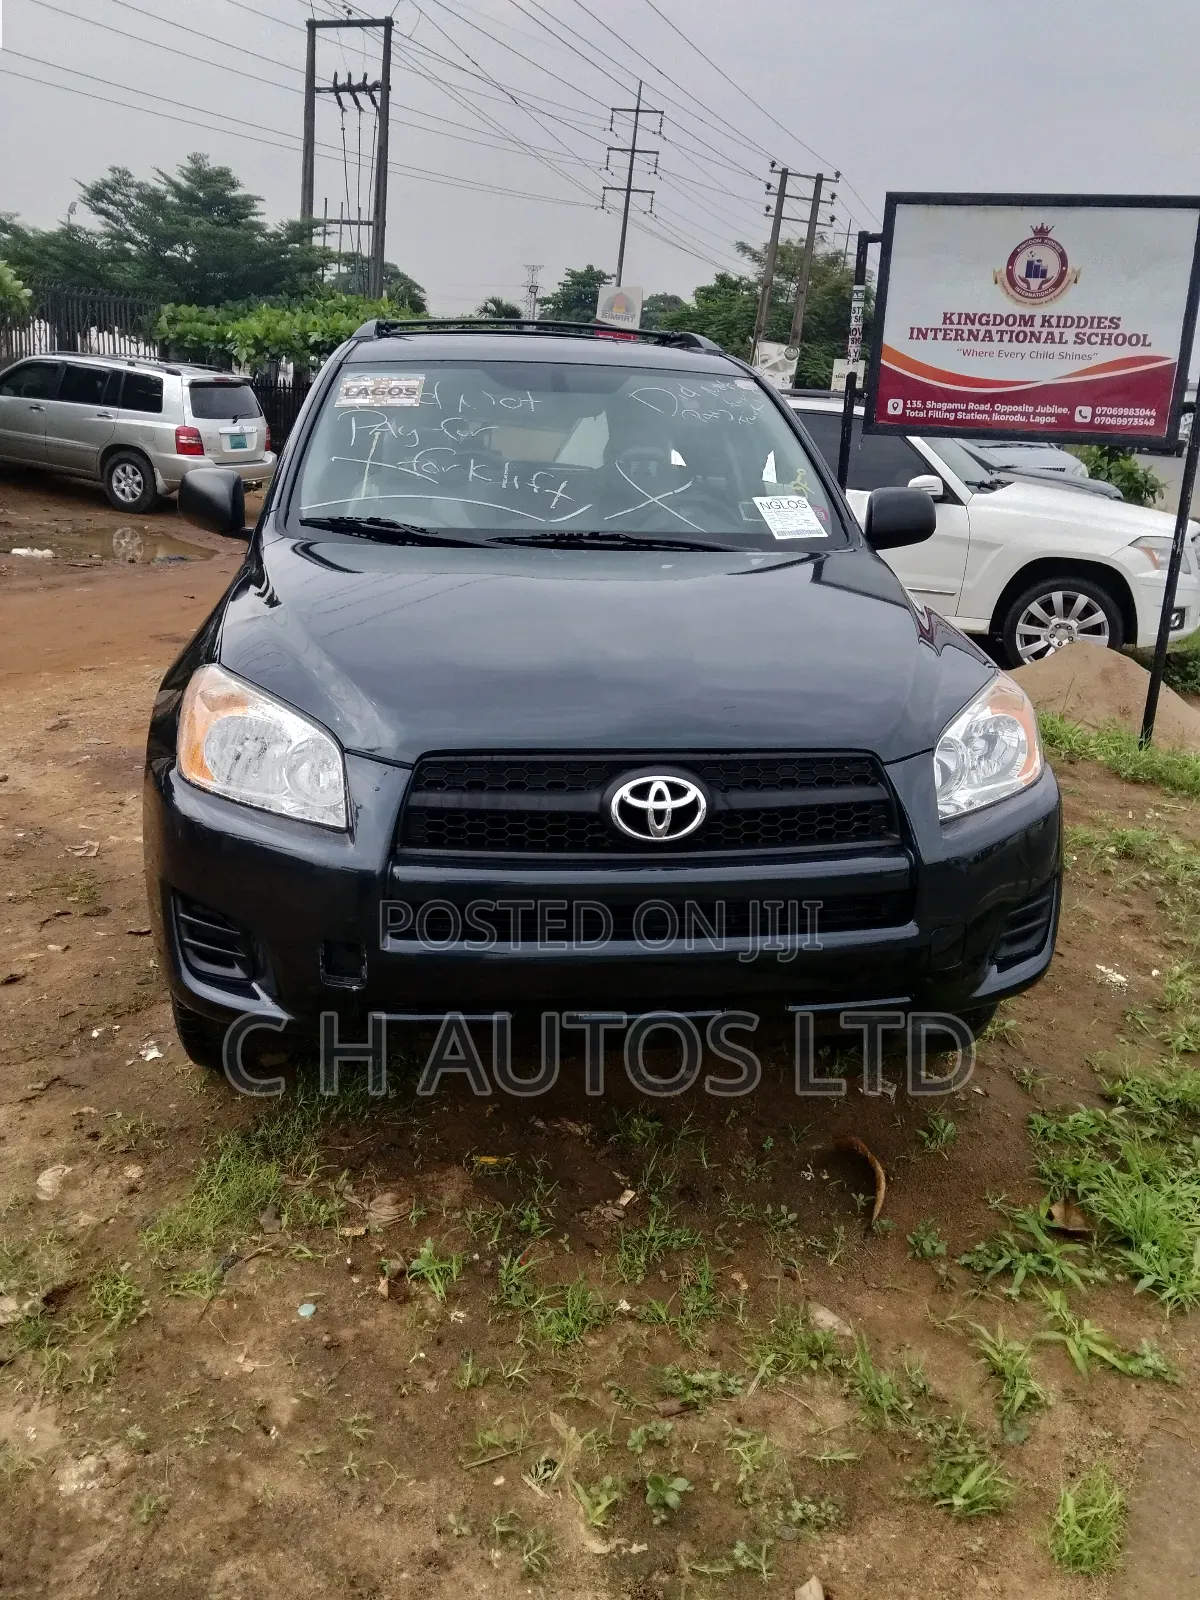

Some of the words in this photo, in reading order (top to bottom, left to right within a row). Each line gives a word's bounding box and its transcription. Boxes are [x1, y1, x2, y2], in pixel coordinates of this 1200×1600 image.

[1013, 286, 1057, 298] INTERNATIONAL
[941, 312, 1036, 327] KINGDOM
[1040, 315, 1121, 330] KIDDIES
[908, 327, 1068, 345] INTERNATIONAL
[1073, 331, 1152, 347] SCHOOL
[997, 349, 1026, 360] Every
[1029, 350, 1055, 360] Child
[343, 387, 418, 397] LAGOS
[906, 400, 924, 409] 135,
[925, 401, 966, 412] Shagamu
[968, 403, 993, 412] Road,
[994, 403, 1034, 413] Opposite
[1036, 404, 1071, 414] Jubilee,
[905, 409, 926, 418] Total
[928, 411, 955, 420] Filling
[956, 412, 990, 421] Station,
[992, 412, 1028, 422] Ikorodu,
[1030, 414, 1058, 424] Lagos.
[759, 499, 808, 511] NGLOS
